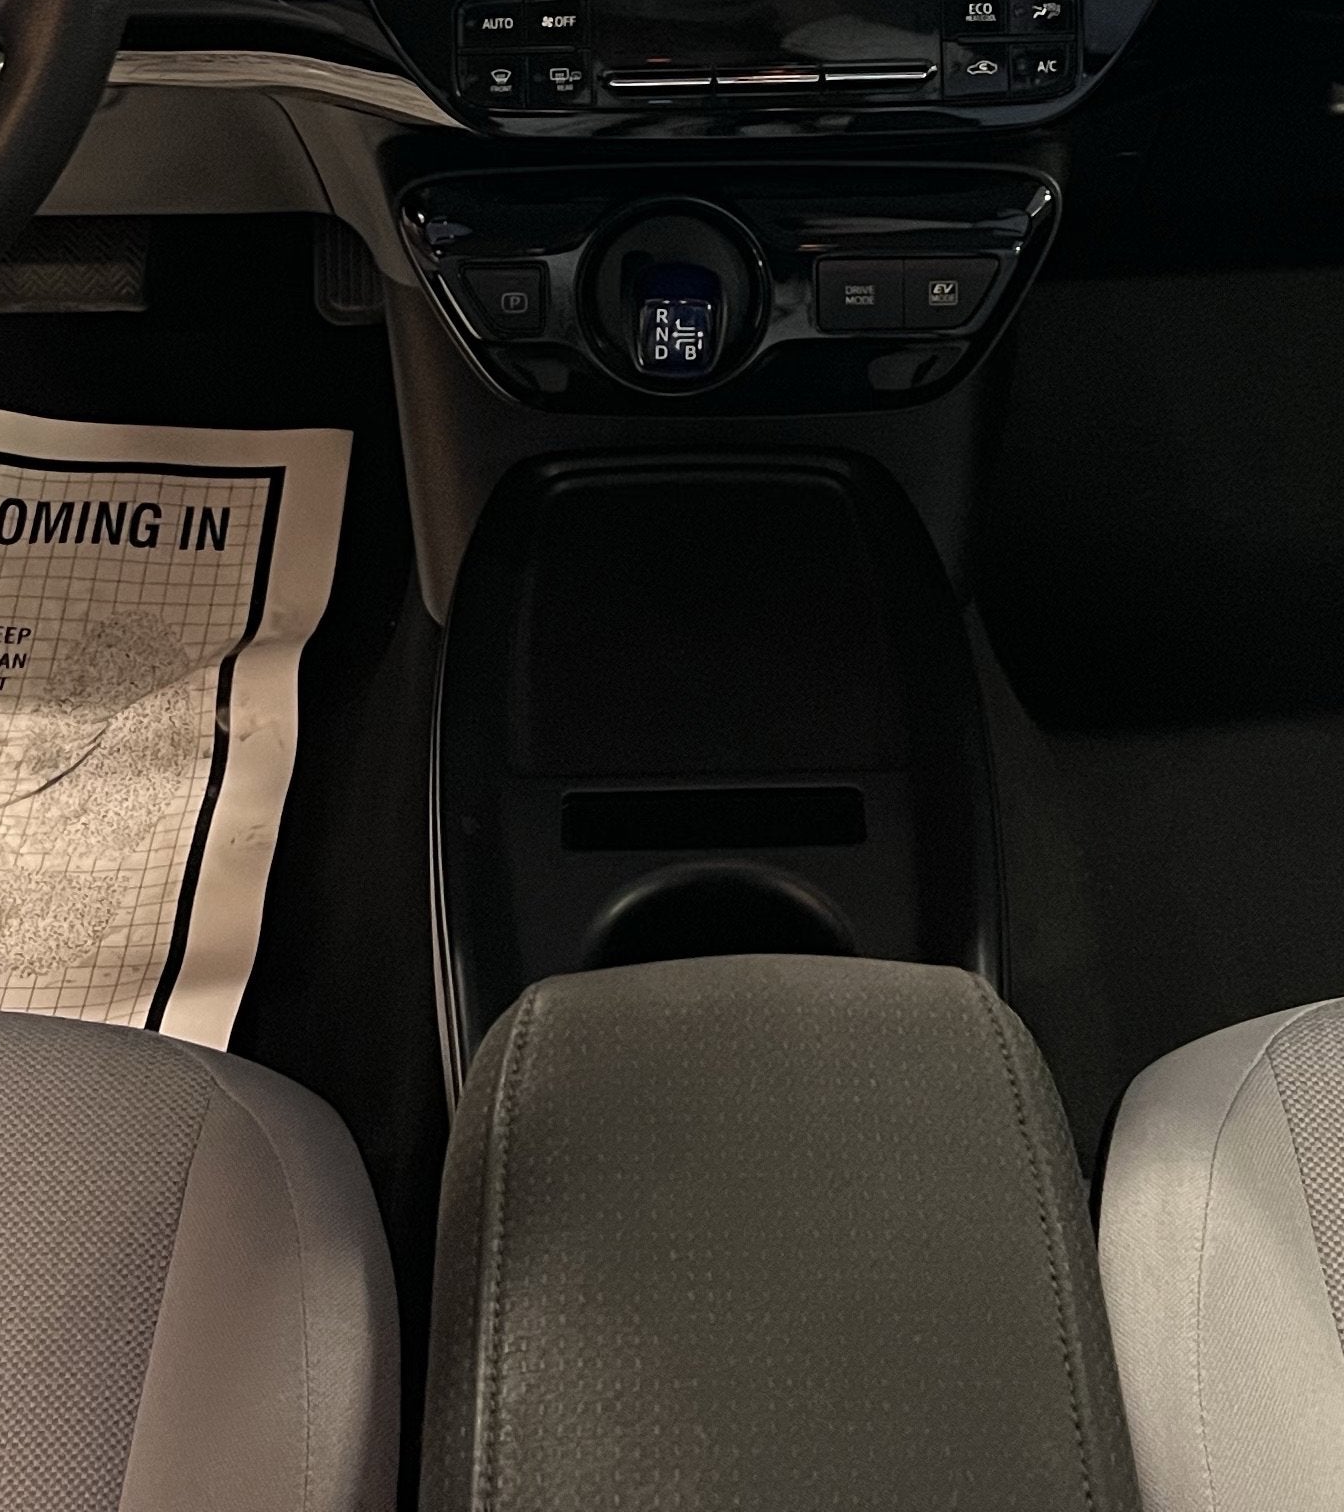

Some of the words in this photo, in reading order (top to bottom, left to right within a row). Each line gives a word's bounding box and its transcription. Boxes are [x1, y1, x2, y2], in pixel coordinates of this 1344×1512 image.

[968, 2, 993, 15] ECO
[481, 17, 514, 30] AUTO
[554, 15, 576, 28] OFF
[1037, 60, 1058, 74] A/C
[845, 285, 875, 295] DRIVE
[932, 283, 954, 294] EV
[845, 296, 875, 305] MODE
[656, 308, 668, 324] R
[656, 327, 668, 342] N
[655, 345, 668, 360] D
[685, 345, 697, 360] B
[179, 505, 231, 552] IN
